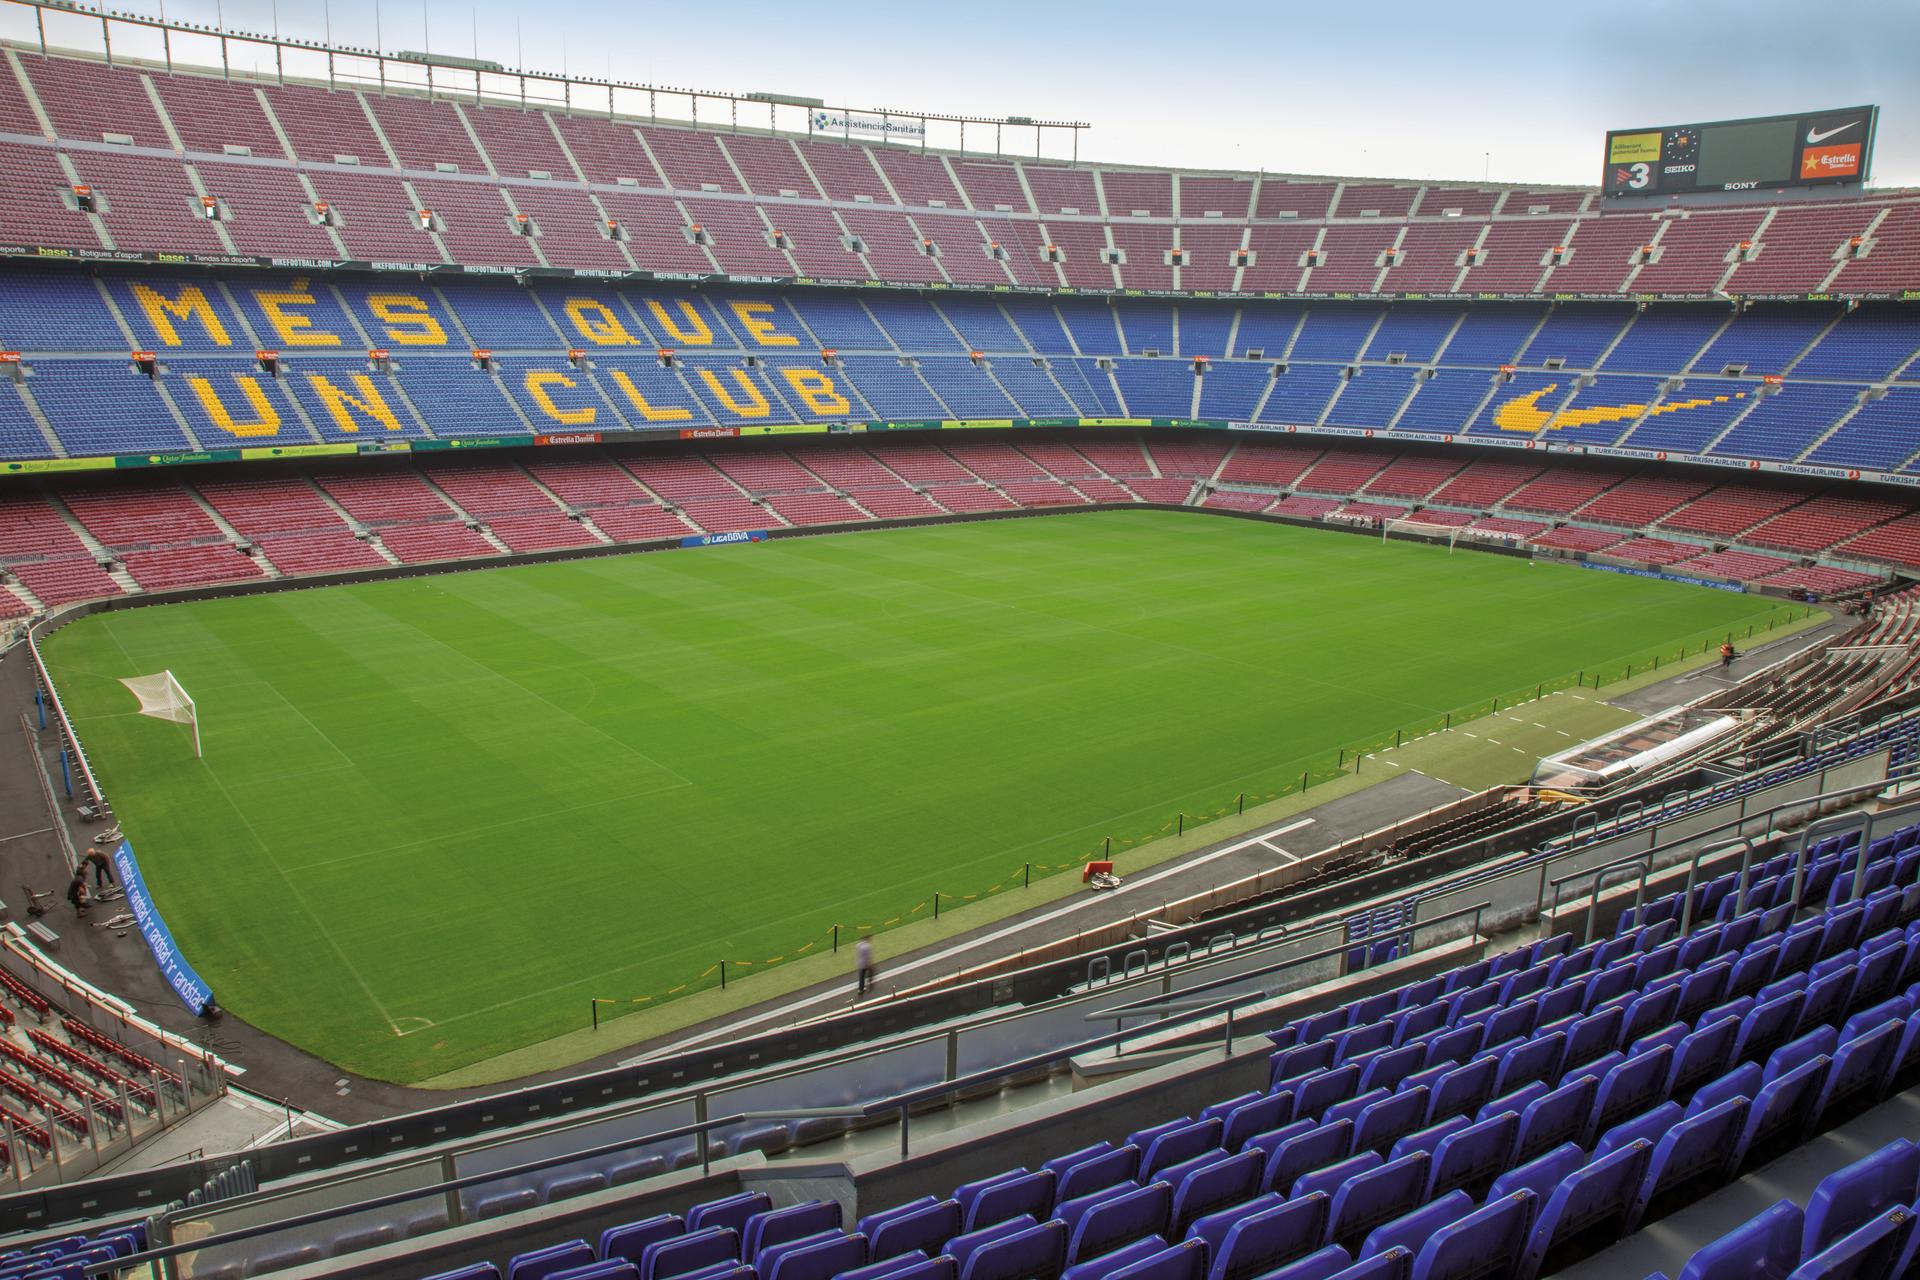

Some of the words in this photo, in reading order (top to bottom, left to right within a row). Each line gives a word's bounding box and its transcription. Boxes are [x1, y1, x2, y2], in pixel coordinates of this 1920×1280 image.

[1821, 153, 1856, 165] Estrella
[1664, 164, 1695, 174] SEIKO
[1629, 162, 1650, 188] 3
[1724, 181, 1758, 190] SONY
[0, 246, 26, 254] eporte
[39, 246, 73, 257] base:
[80, 249, 112, 258] Botigues
[114, 251, 142, 259] d'esport
[159, 252, 190, 262] base:
[194, 254, 219, 262] Tiendas
[231, 256, 256, 264] deporte
[272, 258, 332, 268] NIKEFOOTBALL.COM
[371, 261, 427, 271] NIKEFOOTBALL.COM
[463, 265, 515, 274] NIKEFOOTBALL.COM
[574, 269, 622, 277] NIKEFOOTBALL.COM
[653, 272, 699, 280] NIKEFOOTBALL.COM
[729, 275, 772, 283] NIKEFOOTBALL.COM
[132, 277, 449, 346] MÉS
[563, 297, 800, 346] QUE
[190, 375, 402, 438] UN
[524, 368, 851, 424] CLUB
[693, 430, 715, 438] Estrella
[1336, 428, 1363, 436] AIRLINES
[1388, 431, 1413, 439] TURKISH
[1413, 433, 1442, 441] AIRLINES
[549, 435, 574, 444] Estrella
[575, 435, 594, 443] Damm
[1468, 437, 1495, 445] TURKISH
[1495, 439, 1524, 447] AIRLINES
[1594, 447, 1623, 455] TURKISH
[1623, 450, 1654, 459] AIRLINES
[1683, 455, 1713, 464] TURKISH
[1713, 458, 1747, 468] AIRLINES
[1778, 464, 1810, 474] TURKISH
[1810, 468, 1845, 478] AIRLINES
[1879, 474, 1915, 485] TURKISH
[131, 889, 152, 922] randstad
[149, 927, 174, 965] randstad
[173, 970, 208, 1010] randstad
